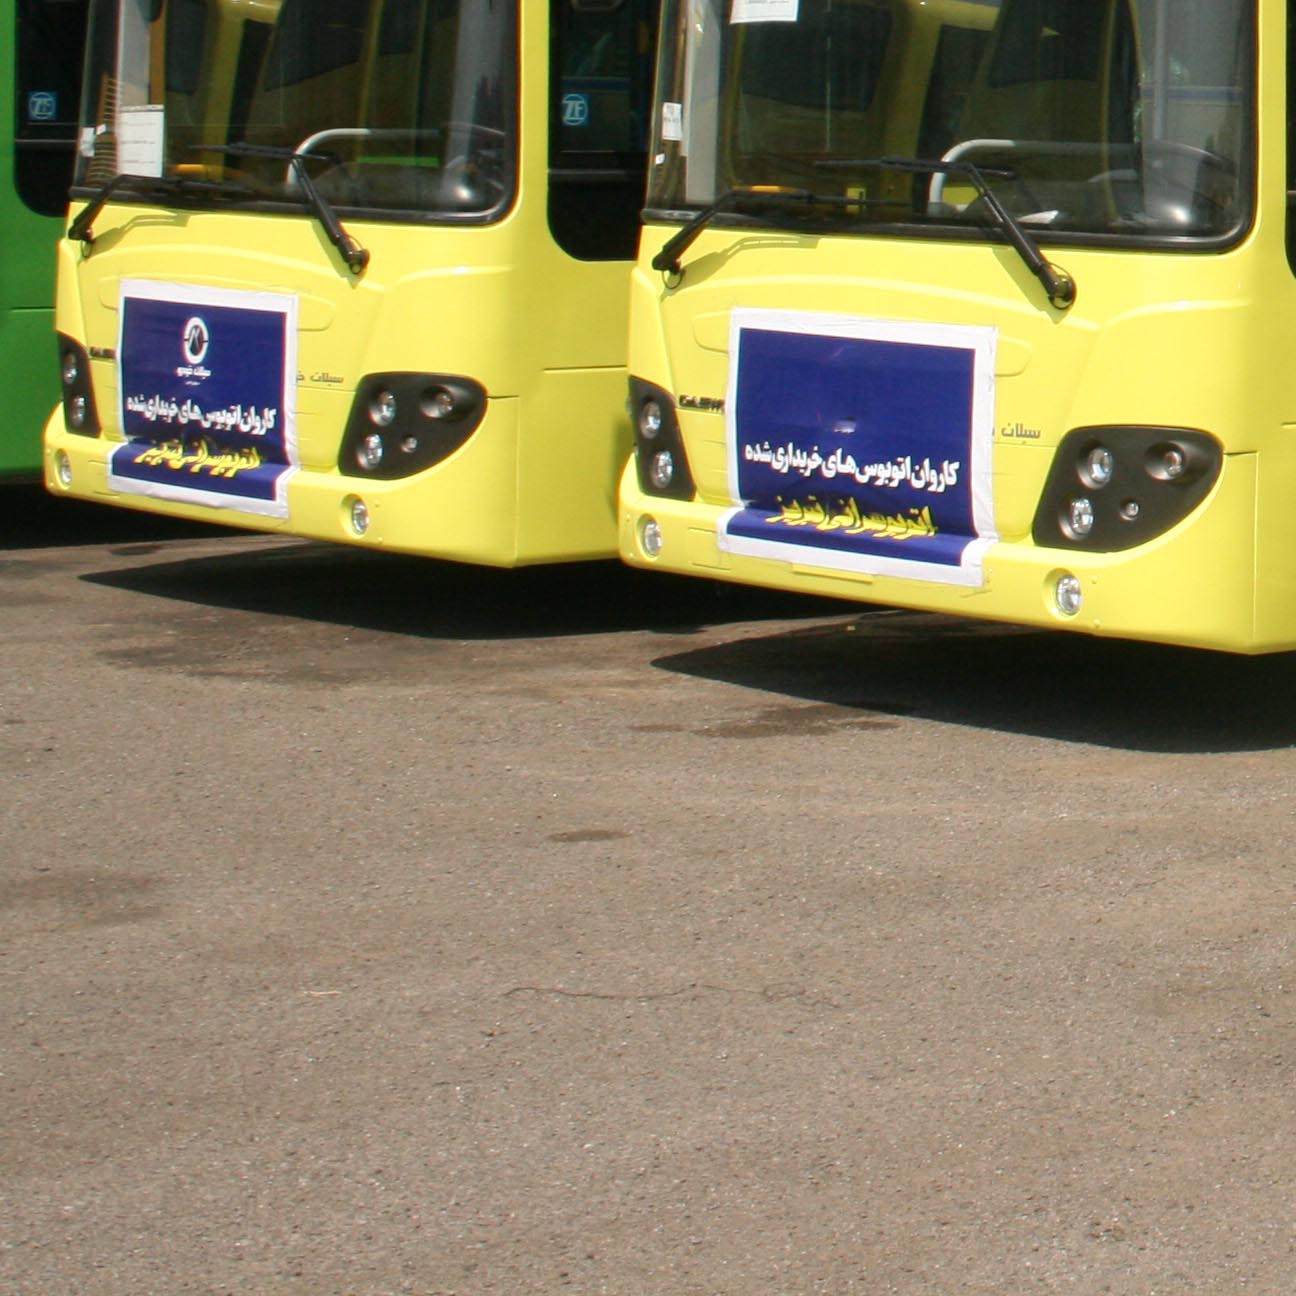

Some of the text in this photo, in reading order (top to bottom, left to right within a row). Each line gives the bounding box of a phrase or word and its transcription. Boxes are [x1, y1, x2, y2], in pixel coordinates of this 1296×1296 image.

[745, 440, 772, 463] شده
[771, 442, 823, 477] خریداری
[911, 457, 960, 493] کاروان
